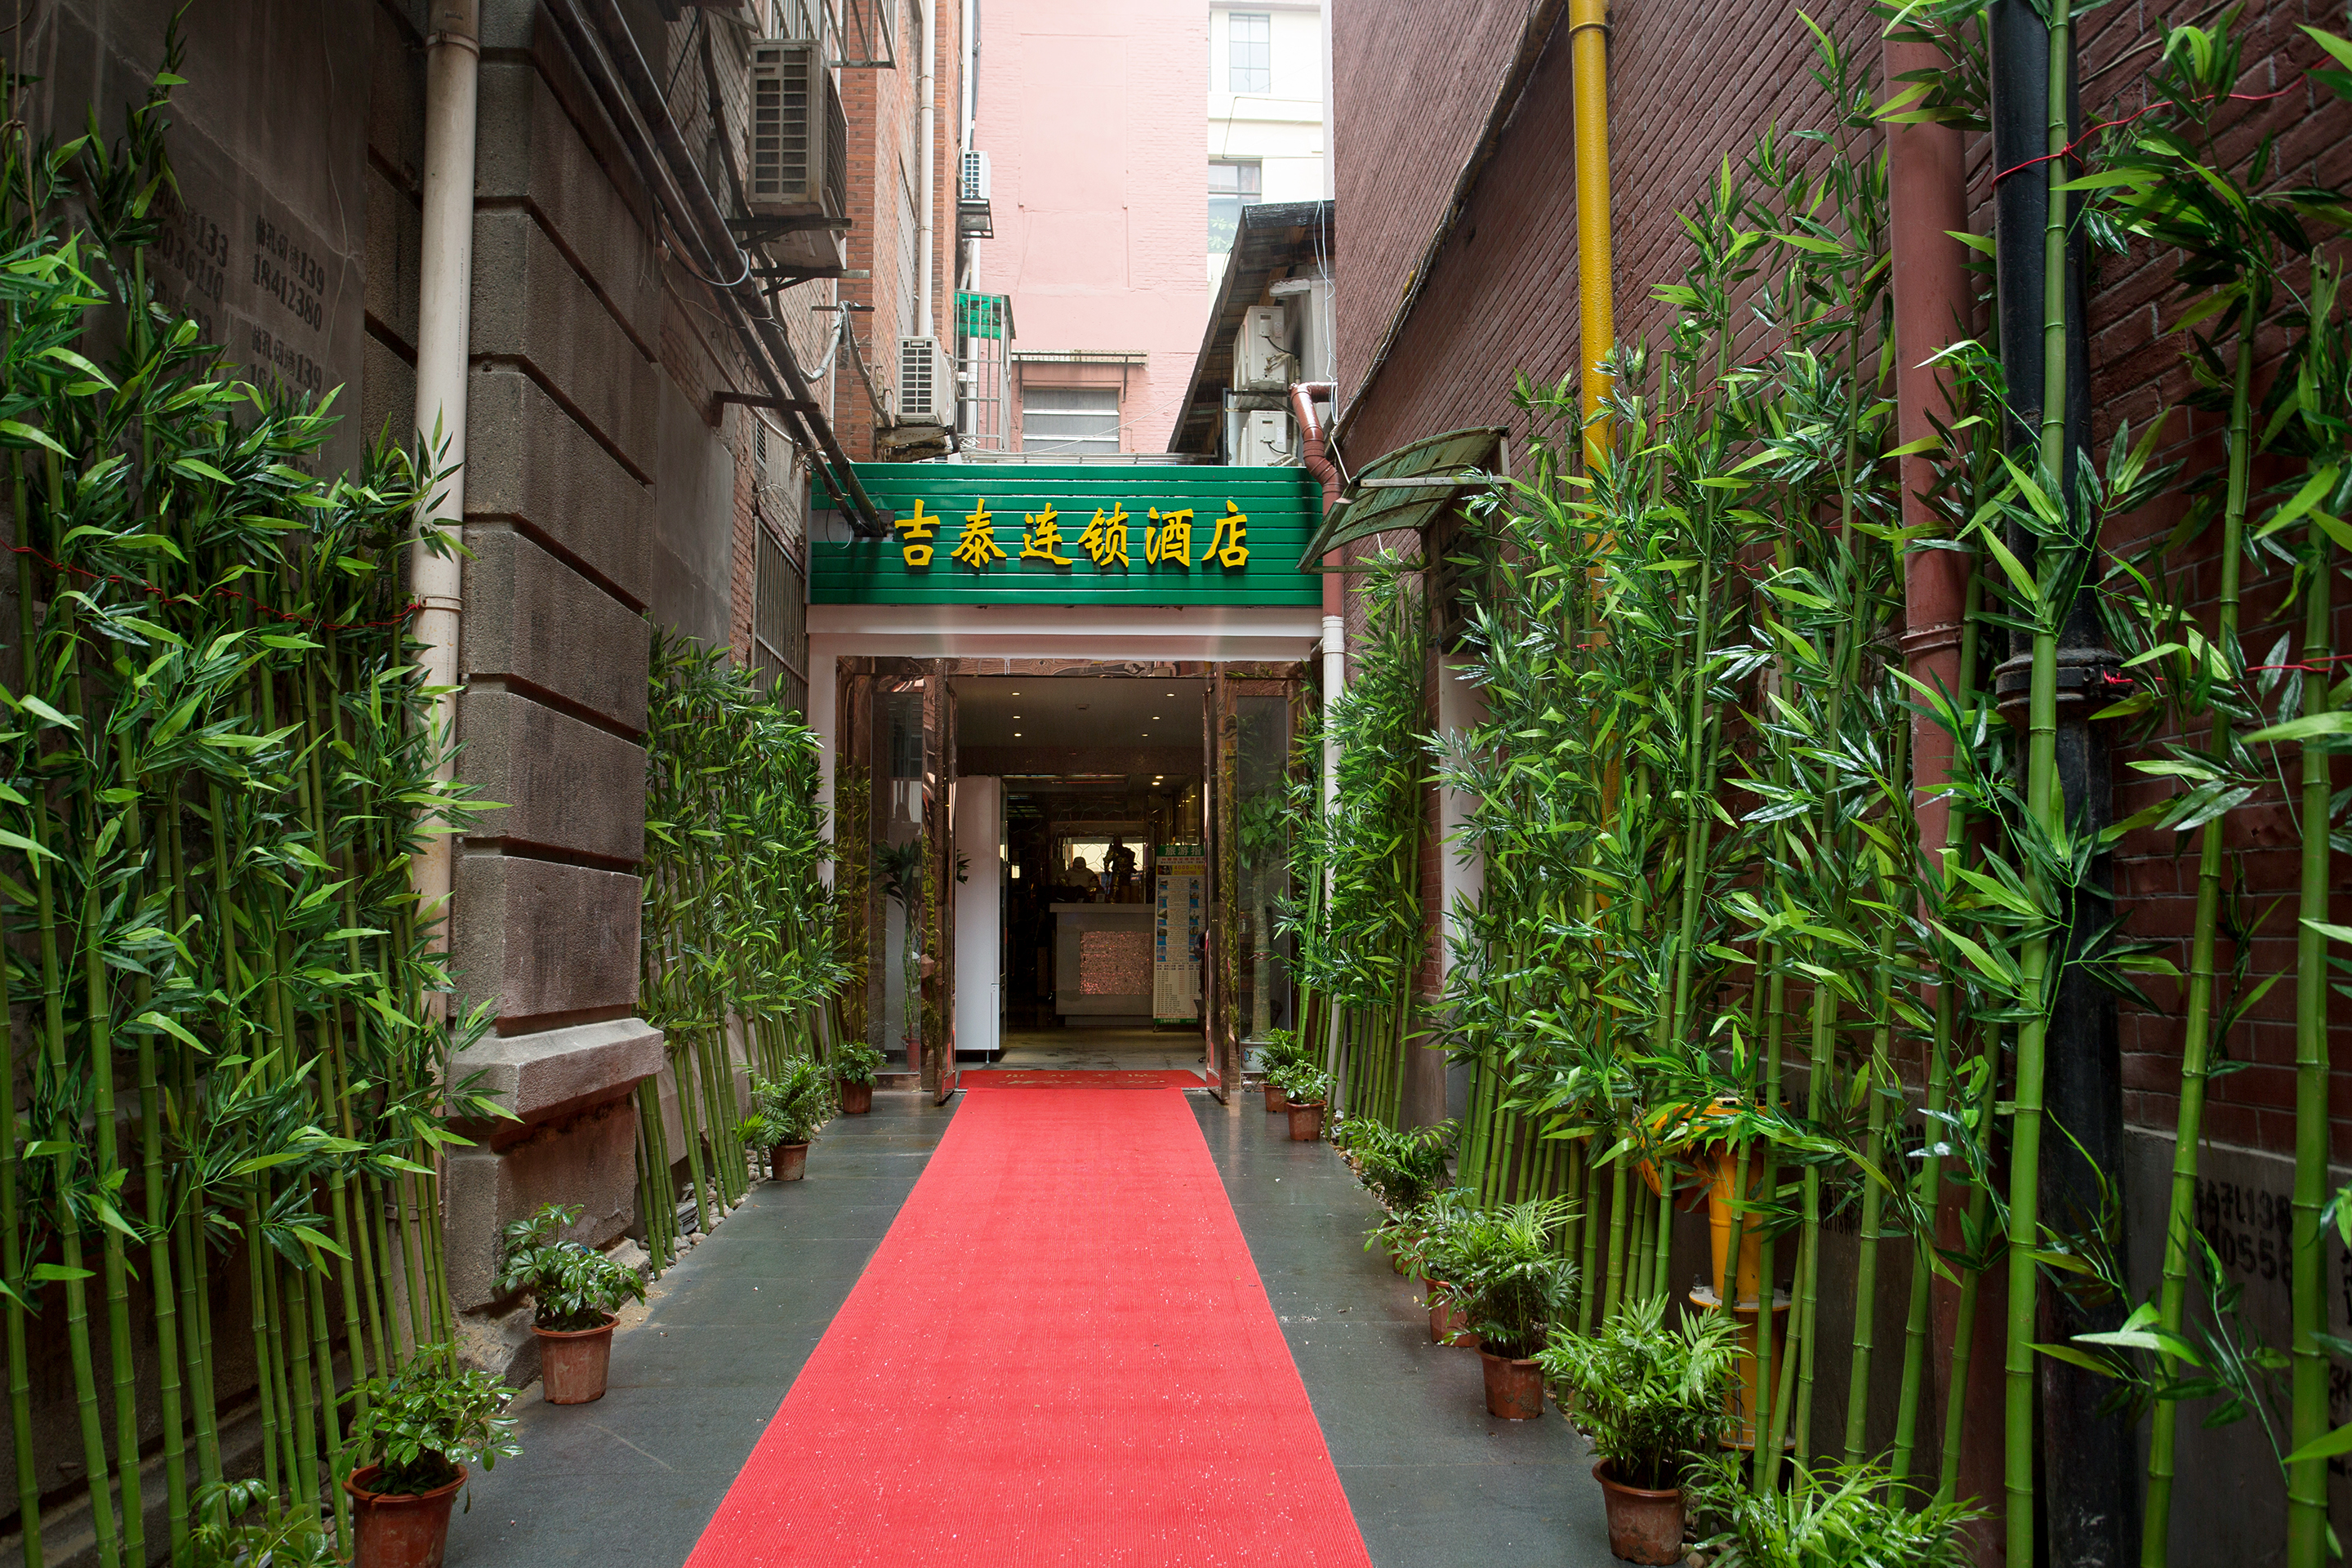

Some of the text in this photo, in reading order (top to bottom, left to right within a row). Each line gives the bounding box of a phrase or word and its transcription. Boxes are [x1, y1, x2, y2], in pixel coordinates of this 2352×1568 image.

[252, 252, 323, 333] 18412380
[894, 497, 1250, 568] 吉泰连锁酒店
